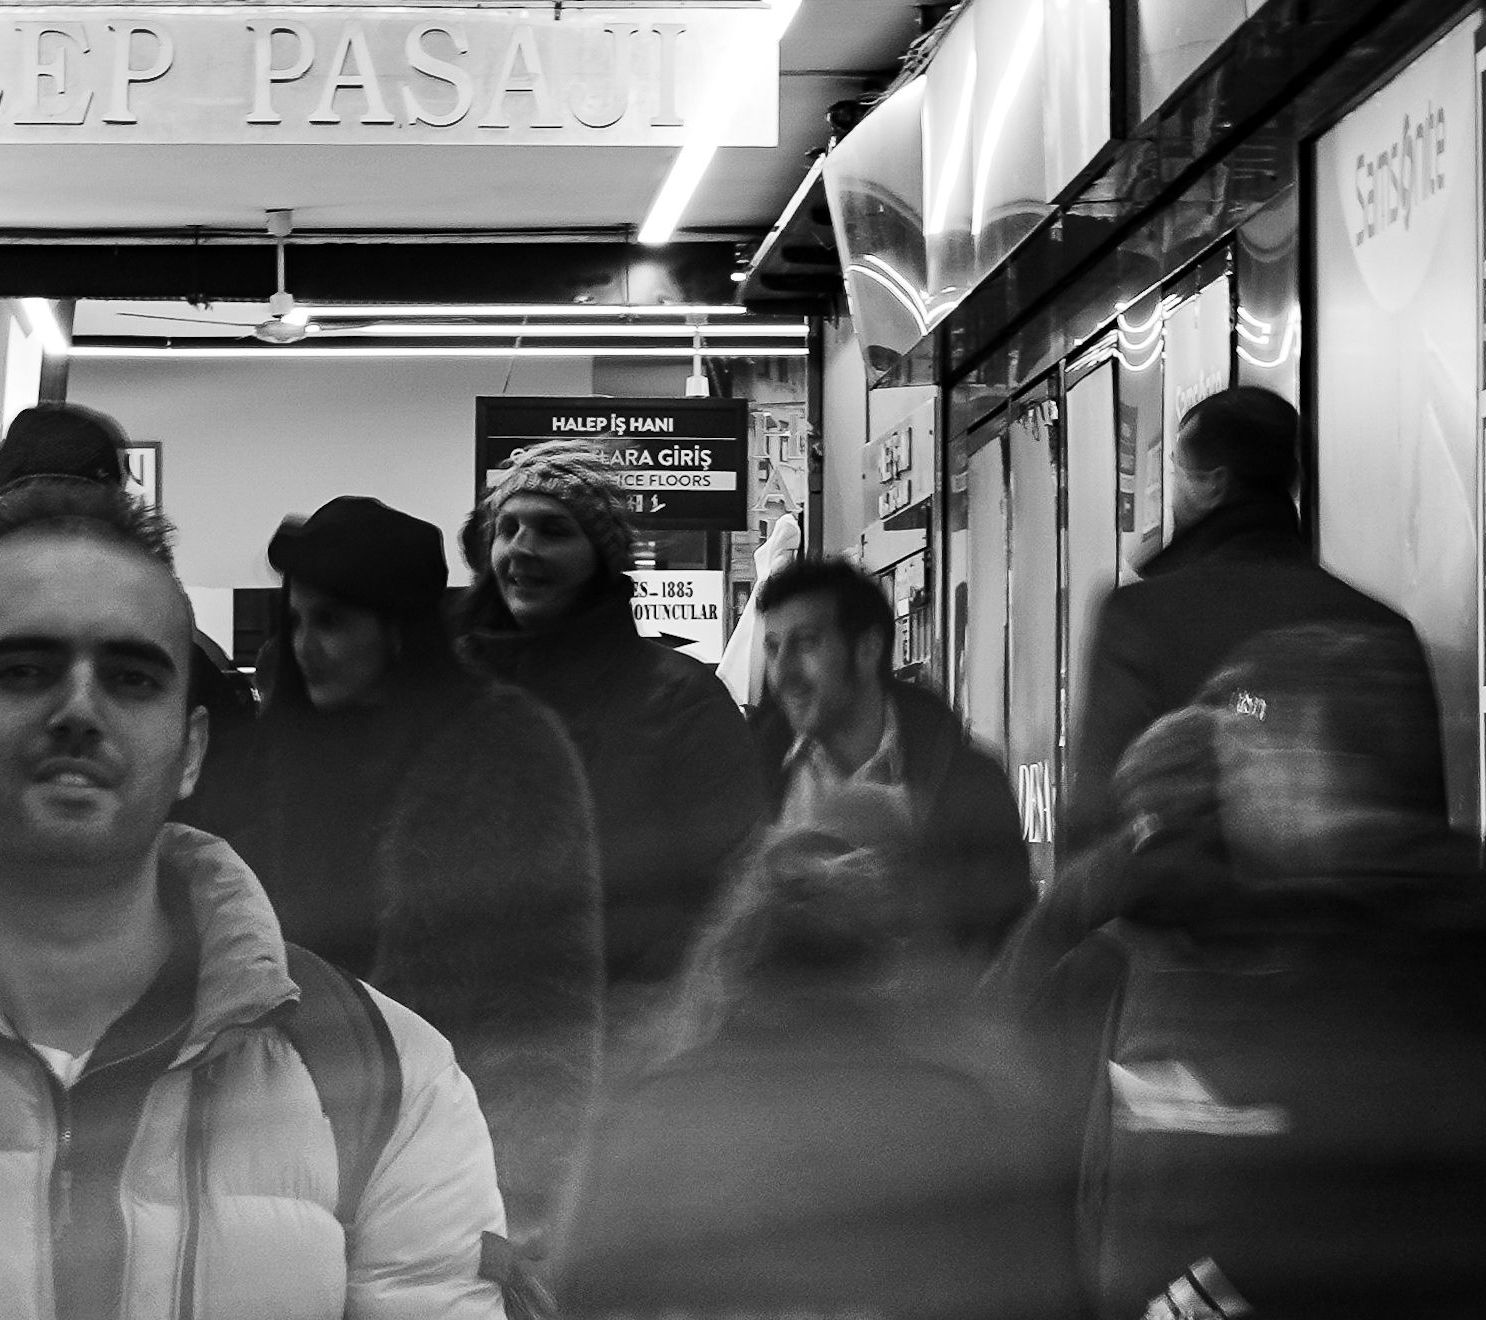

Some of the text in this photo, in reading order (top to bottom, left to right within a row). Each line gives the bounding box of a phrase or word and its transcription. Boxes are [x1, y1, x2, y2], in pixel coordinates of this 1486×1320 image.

[243, 18, 692, 129] PASAJI
[551, 412, 675, 436] HALEP İŞ HANI
[657, 444, 713, 471] GİRİŞ
[649, 473, 712, 488] FLOORS
[633, 603, 718, 621] OYUNCULAR
